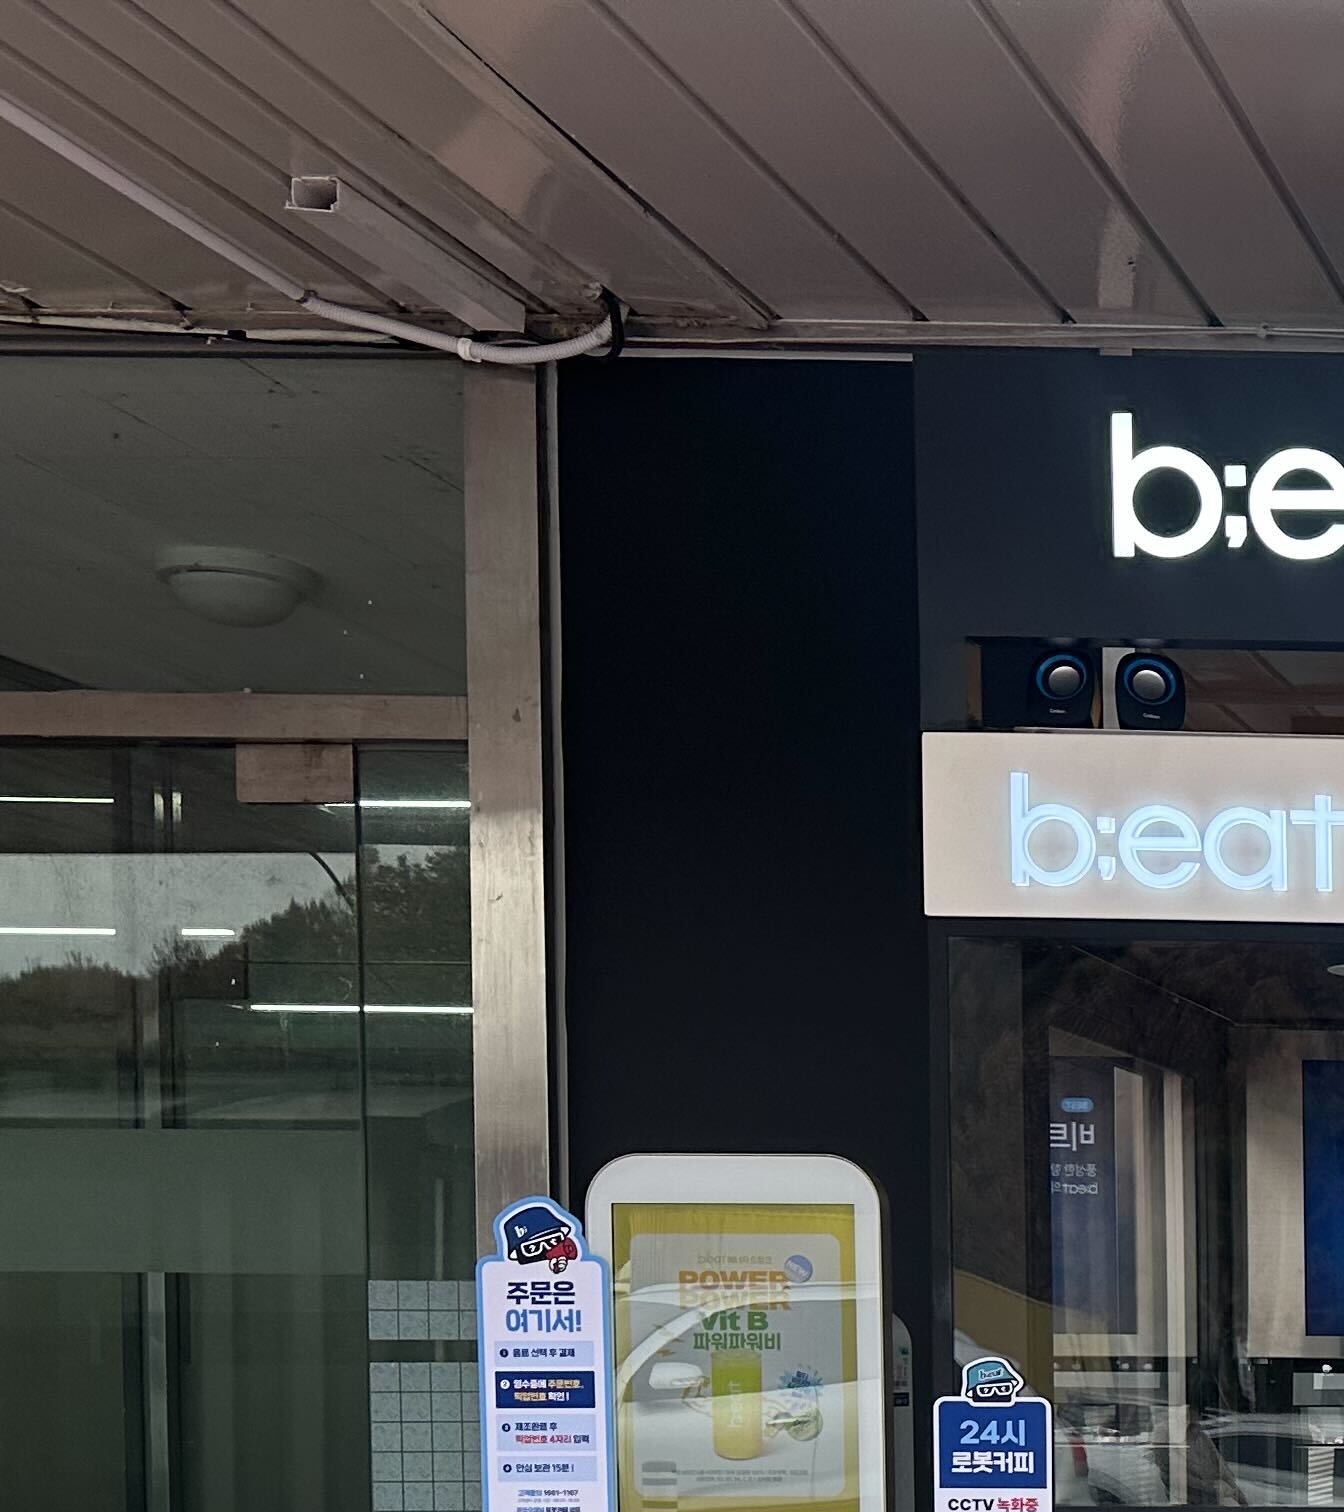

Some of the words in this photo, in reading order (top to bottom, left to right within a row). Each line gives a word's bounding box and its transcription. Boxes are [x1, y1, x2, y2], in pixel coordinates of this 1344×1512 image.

[679, 1270, 792, 1290] POWER
[506, 1281, 576, 1305] 주문은
[506, 1309, 582, 1333] 여기서!
[748, 1312, 769, 1331] B
[693, 1332, 781, 1350] 파워파워비
[959, 1420, 1026, 1447] 24시
[951, 1451, 1034, 1474] 로봇커피
[948, 1498, 995, 1511] CCTV
[997, 1498, 1039, 1512] 녹화중
